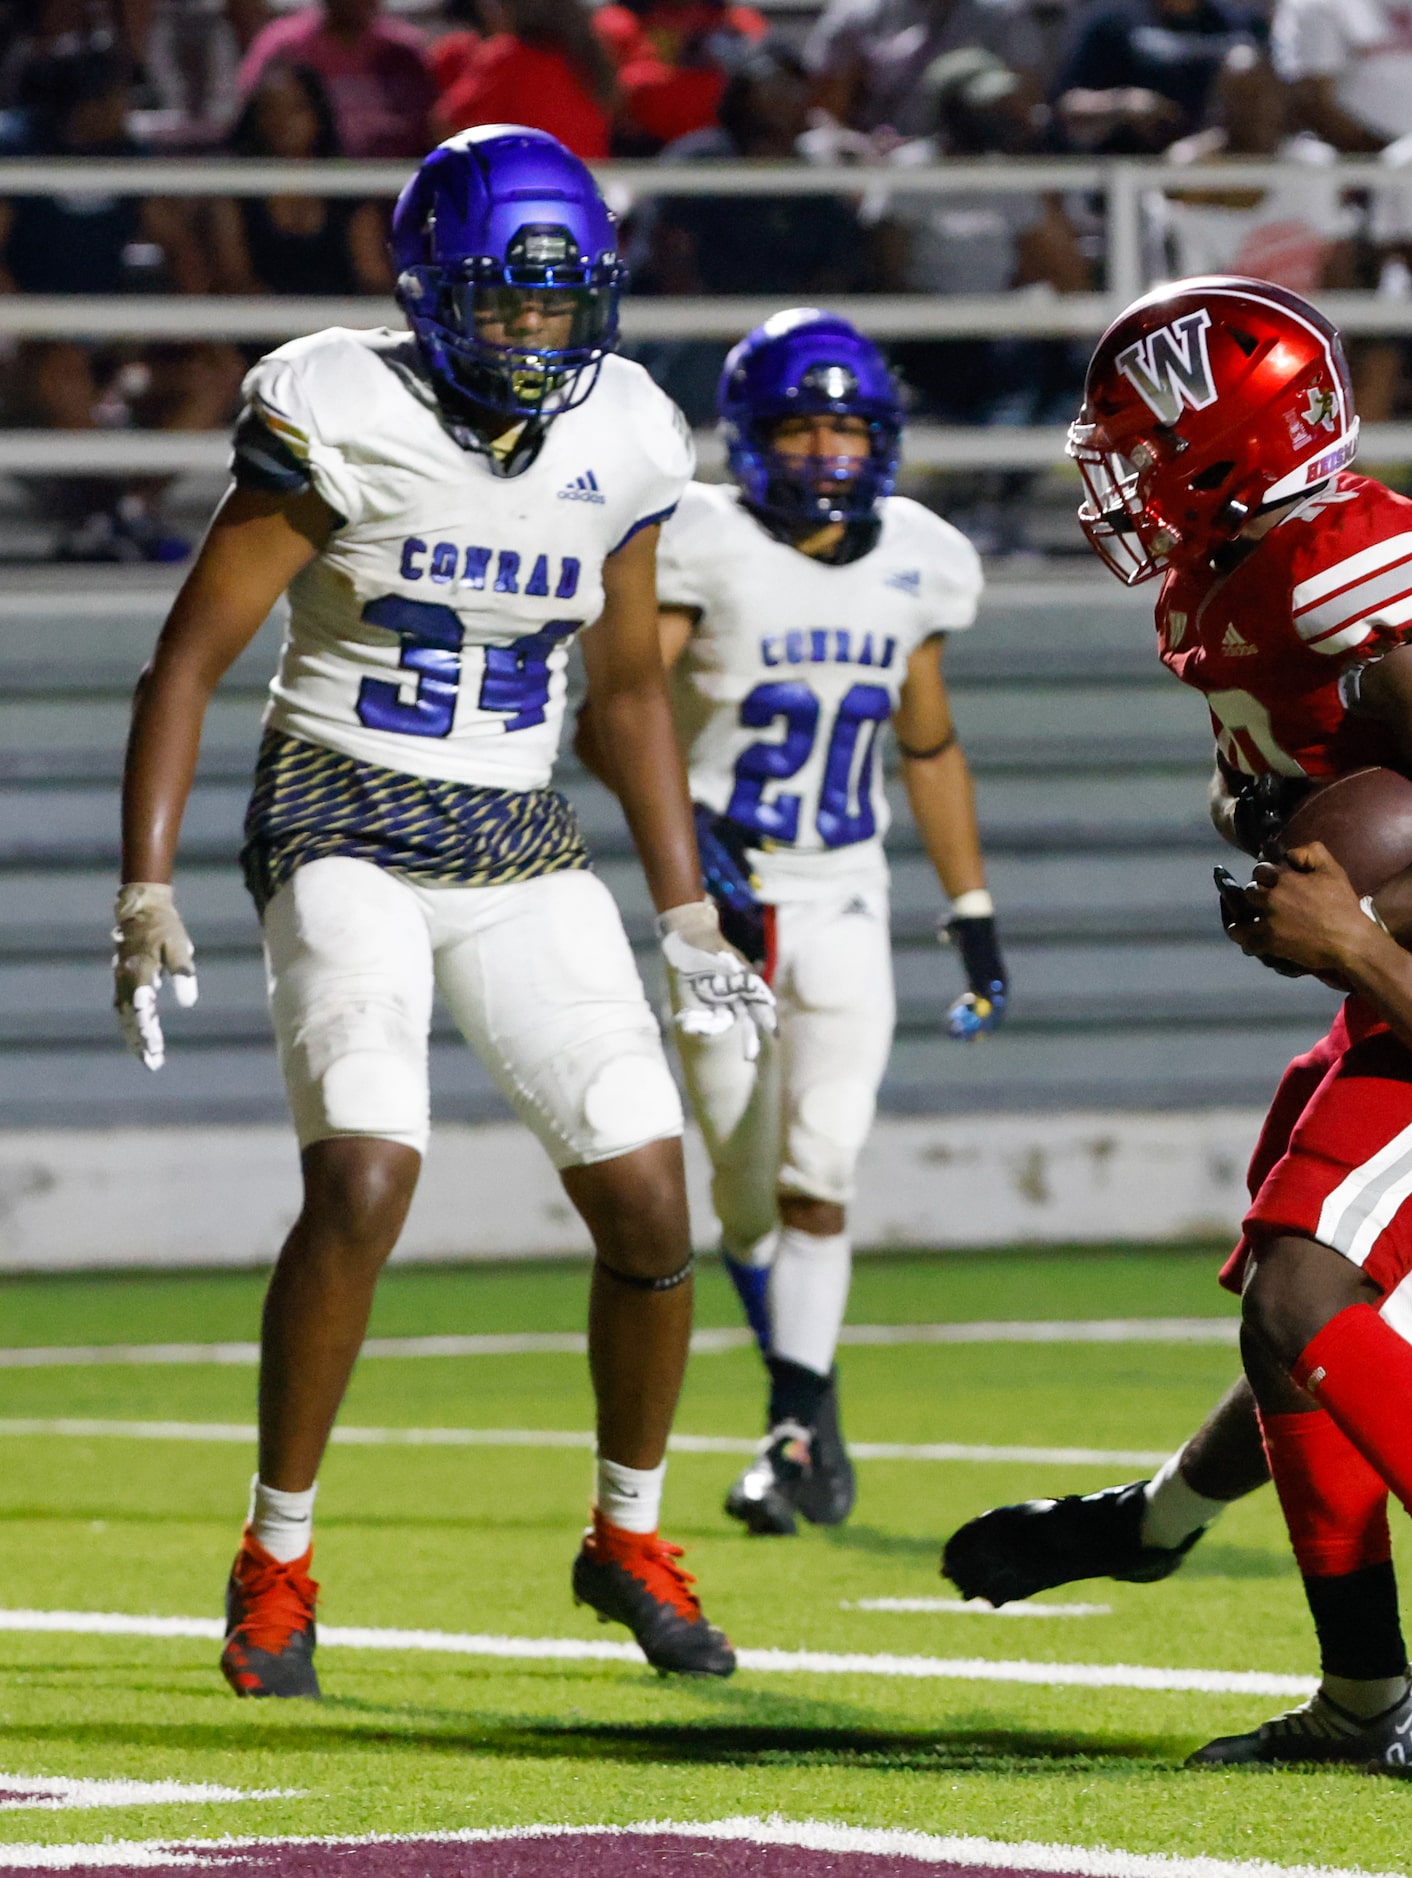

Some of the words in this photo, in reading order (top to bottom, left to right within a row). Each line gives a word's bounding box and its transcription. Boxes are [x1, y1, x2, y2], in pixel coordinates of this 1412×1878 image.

[1114, 308, 1219, 428] W
[400, 536, 581, 600] CONRAD
[356, 592, 585, 739] 34
[760, 628, 896, 668] CONRAD
[726, 680, 890, 848] 20
